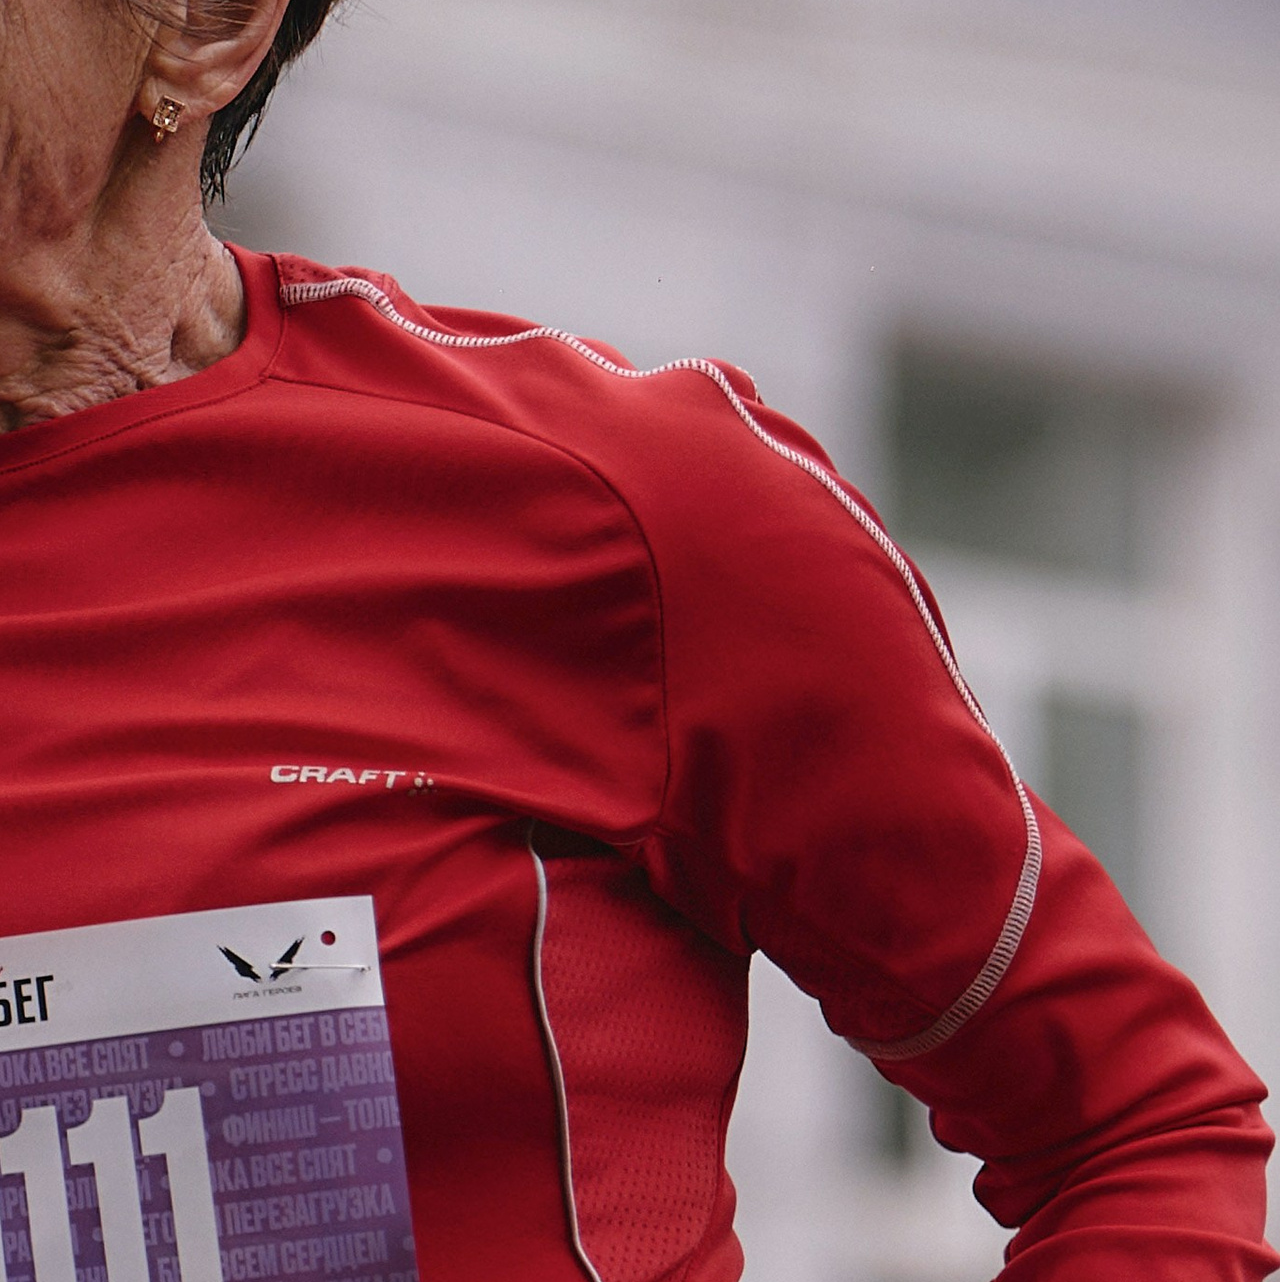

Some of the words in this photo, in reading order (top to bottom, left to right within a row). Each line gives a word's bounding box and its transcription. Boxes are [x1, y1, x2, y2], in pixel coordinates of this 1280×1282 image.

[270, 765, 406, 789] CRAFT
[44, 1045, 90, 1081] ВСЕ
[91, 1037, 149, 1075] СПЯТ
[201, 1022, 272, 1060] ЛЮБИ
[274, 1016, 314, 1052] БЕГ
[318, 1014, 336, 1046] В
[229, 1057, 318, 1099] СТРЕСС
[222, 1105, 316, 1144] ФИНИШ
[250, 1150, 296, 1187] ВСЕ
[297, 1142, 356, 1180] СПЯТ
[224, 1183, 395, 1234] ПЕРЕЗАГРУЗКА
[279, 1230, 386, 1273] СЕРДЦЕМ
